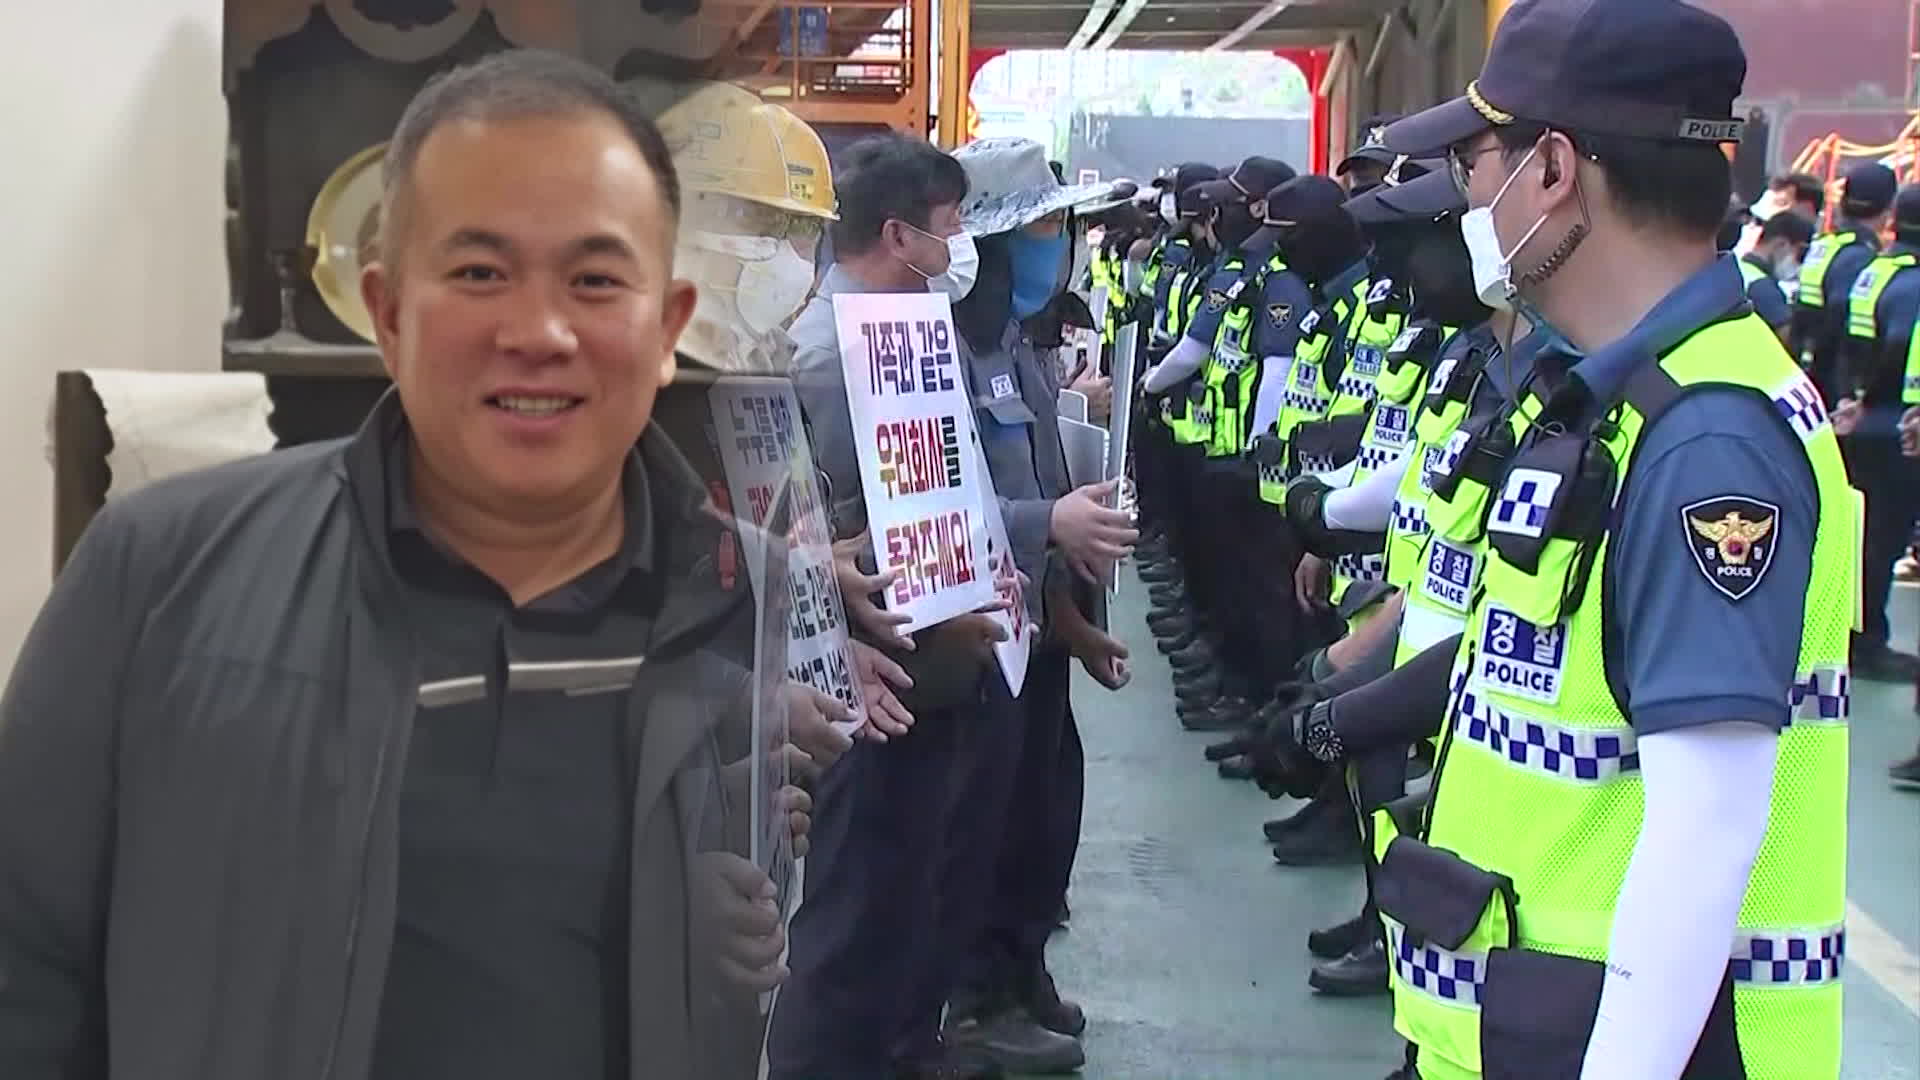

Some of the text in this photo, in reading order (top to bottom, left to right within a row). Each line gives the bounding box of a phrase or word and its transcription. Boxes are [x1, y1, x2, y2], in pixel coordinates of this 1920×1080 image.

[861, 319, 954, 396] 가족과 같은
[1374, 427, 1404, 443] POLICE
[886, 509, 977, 606] 돌려주세요!
[1431, 544, 1470, 586] 경찰
[1717, 567, 1752, 577] POLICE
[1426, 576, 1465, 604] POLICE
[1490, 612, 1561, 667] 경찰
[1484, 660, 1554, 693] POLICE
